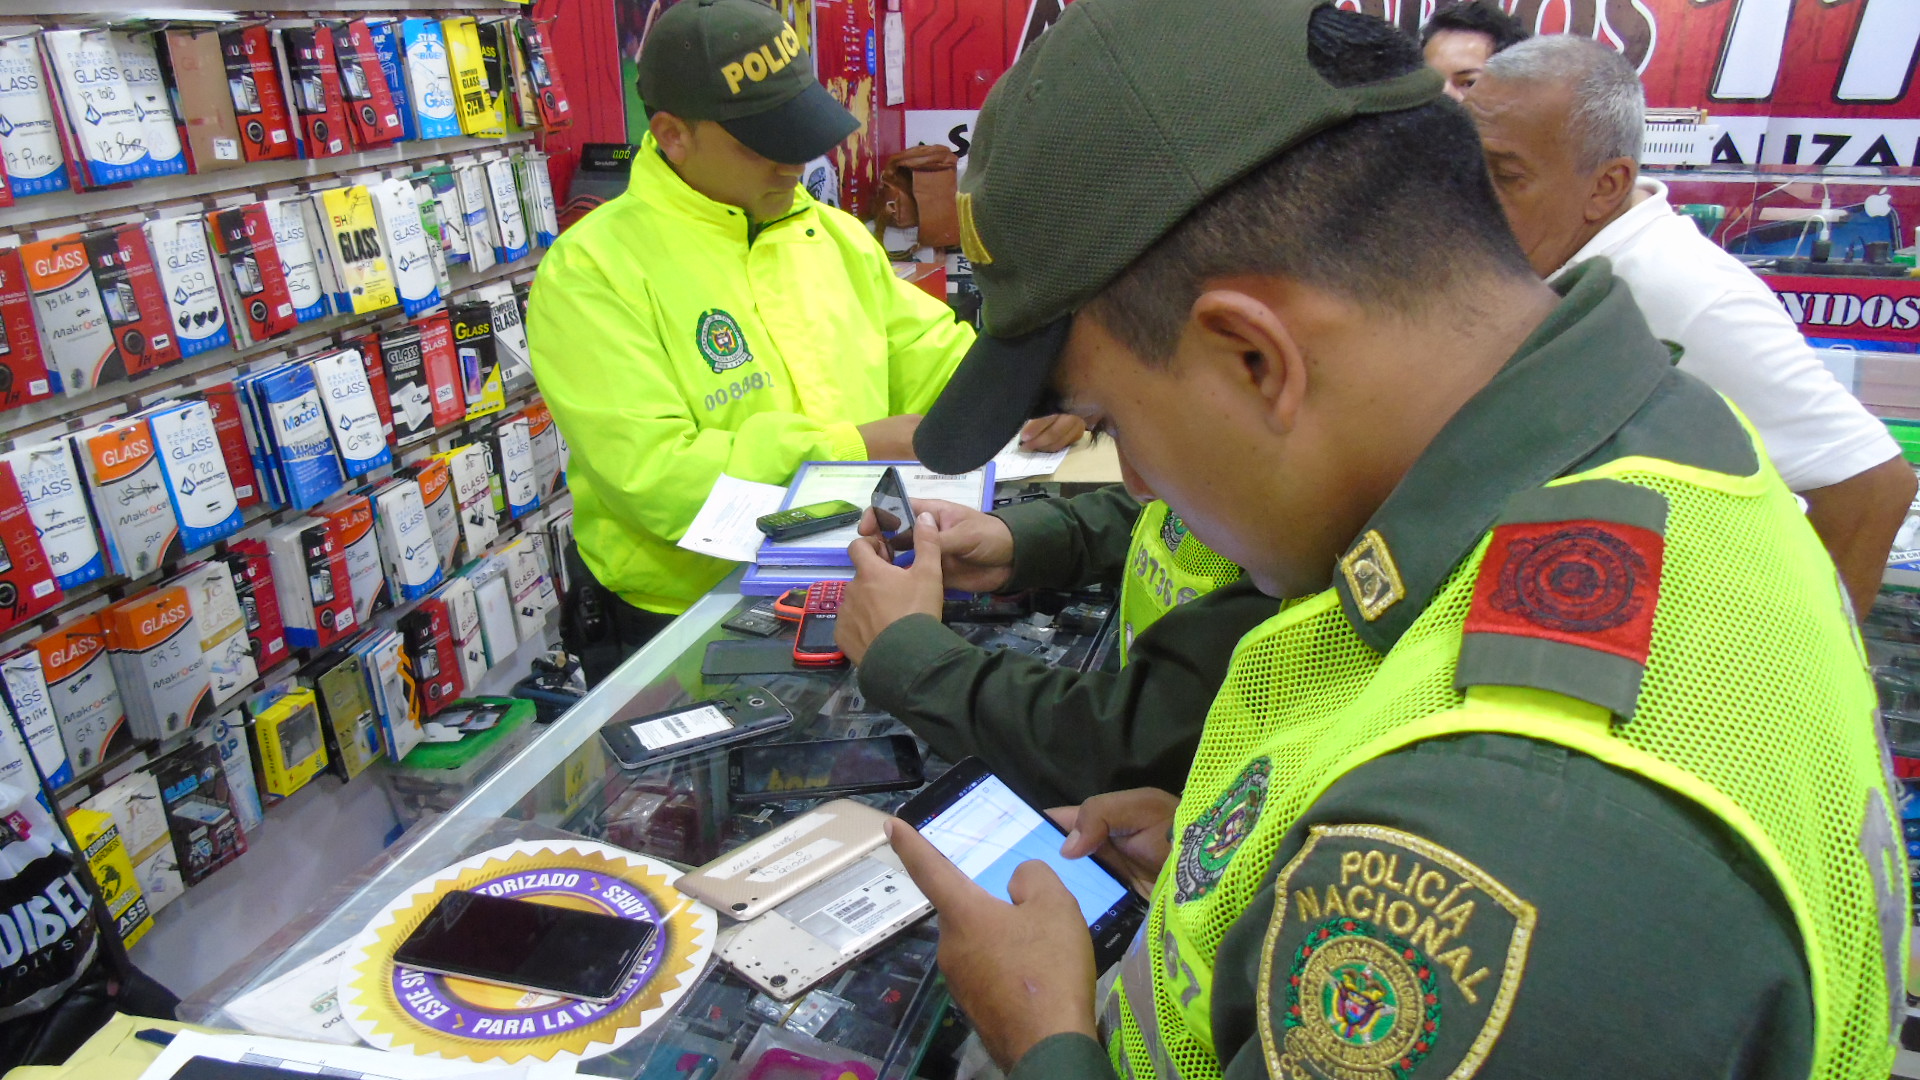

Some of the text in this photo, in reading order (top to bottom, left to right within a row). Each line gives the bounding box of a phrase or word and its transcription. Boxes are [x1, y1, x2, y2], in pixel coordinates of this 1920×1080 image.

[417, 34, 438, 43] STAR
[482, 46, 497, 58] ASS
[0, 75, 38, 92] LASS
[74, 66, 119, 84] GLASS
[123, 68, 160, 82] GLASS
[462, 75, 480, 90] GLASS
[497, 182, 515, 197] GLASS
[333, 214, 347, 228] 9H
[274, 227, 304, 244] GLASS
[393, 223, 421, 241] GLASS
[338, 227, 381, 263] GLASS
[35, 250, 83, 277] GLASS
[167, 249, 206, 269] GLASS
[1772, 289, 1920, 331] NIDOS
[493, 308, 520, 333] GLASS
[455, 322, 490, 340] GLASS
[387, 345, 420, 365] GLASS
[421, 338, 447, 353] GLASS
[332, 381, 367, 399] GLASS
[102, 439, 149, 467] GLASS
[172, 436, 214, 460] GLASS
[507, 441, 529, 459] GLASS
[21, 463, 65, 480] REMIUM
[21, 470, 68, 489] EMPERED
[22, 478, 73, 505] GLASS
[424, 471, 448, 494] GLASS
[460, 472, 486, 495] GLASS
[400, 512, 424, 532] GLASS
[515, 567, 536, 589] GLASS
[141, 604, 187, 635] GLASS
[461, 611, 478, 632] GLASS
[49, 635, 97, 669] GLASS
[15, 689, 42, 710] ASS
[1340, 850, 1476, 938] POLICÍA
[119, 897, 147, 932] ASS
[404, 986, 451, 1021] ESTE
[477, 873, 580, 898] TORIZADO
[1293, 884, 1491, 1005] NACIONAL
[472, 1015, 537, 1036] PARA
[543, 1012, 576, 1030] LA
